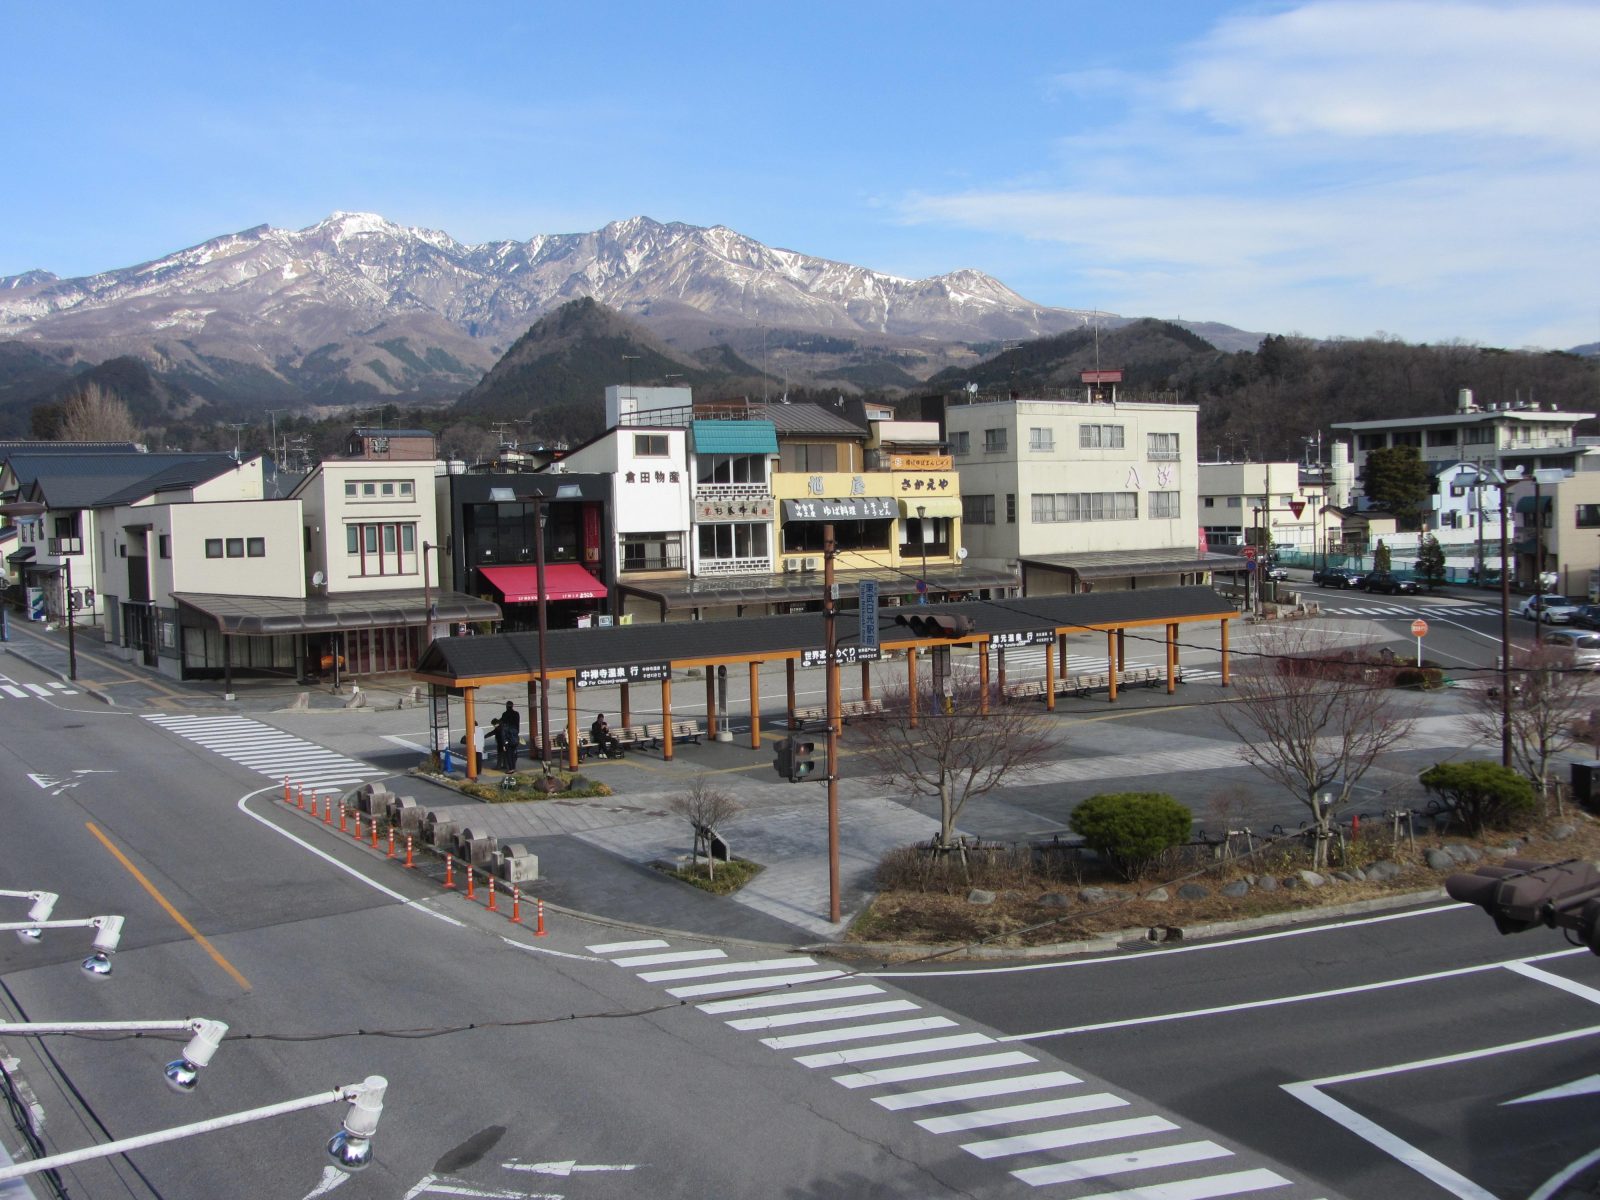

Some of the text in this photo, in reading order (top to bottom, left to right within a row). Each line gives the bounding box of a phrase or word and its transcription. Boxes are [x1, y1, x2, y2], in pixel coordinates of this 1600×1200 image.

[625, 470, 680, 483] 倉田物産
[901, 478, 949, 490] さかえや
[823, 504, 857, 516] ゆば料理
[866, 583, 875, 645] 東武日光駅前
[1026, 631, 1033, 640] 行
[629, 666, 639, 676] 行
